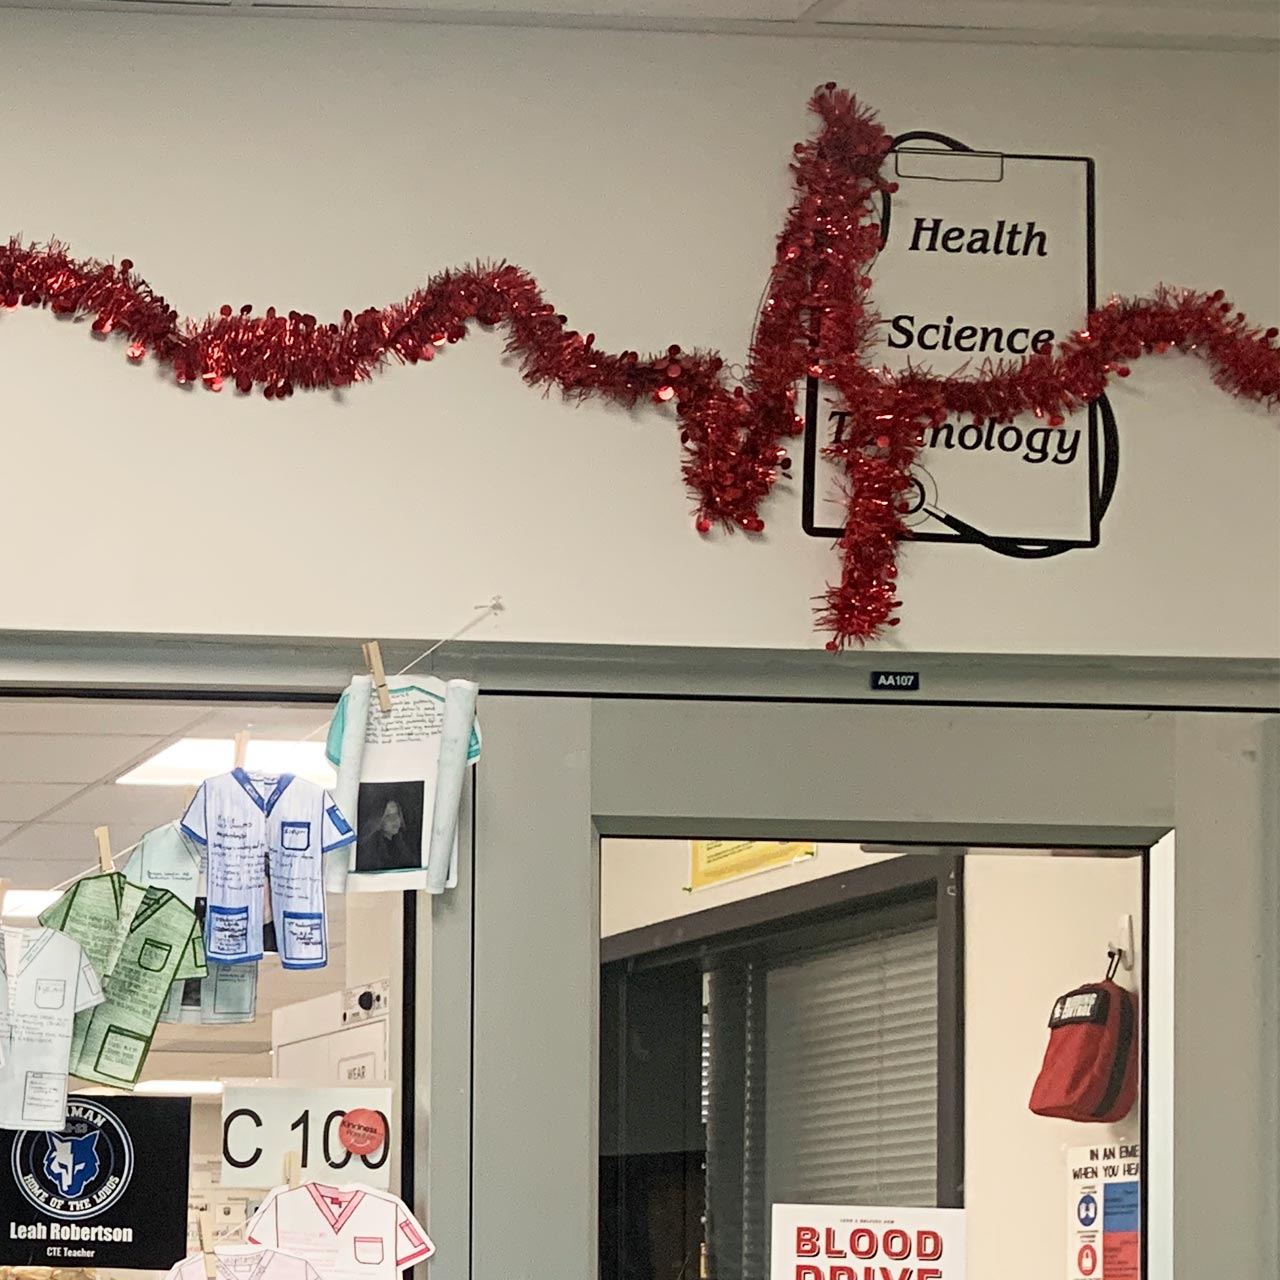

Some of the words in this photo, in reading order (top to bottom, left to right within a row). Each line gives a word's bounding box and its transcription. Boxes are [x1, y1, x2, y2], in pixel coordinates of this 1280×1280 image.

[908, 218, 1048, 257] Health
[888, 316, 1055, 356] Science
[878, 675, 914, 685] AA107
[223, 1108, 262, 1168] C
[24, 1174, 48, 1203] HOME
[50, 1198, 64, 1210] OF
[68, 1199, 92, 1211] THE
[93, 1175, 120, 1203] LOBOS
[10, 1222, 47, 1239] Leah
[50, 1223, 133, 1242] Robertson
[797, 1227, 943, 1261] BLOOD
[47, 1247, 62, 1257] CTE
[63, 1248, 95, 1258] Teacher
